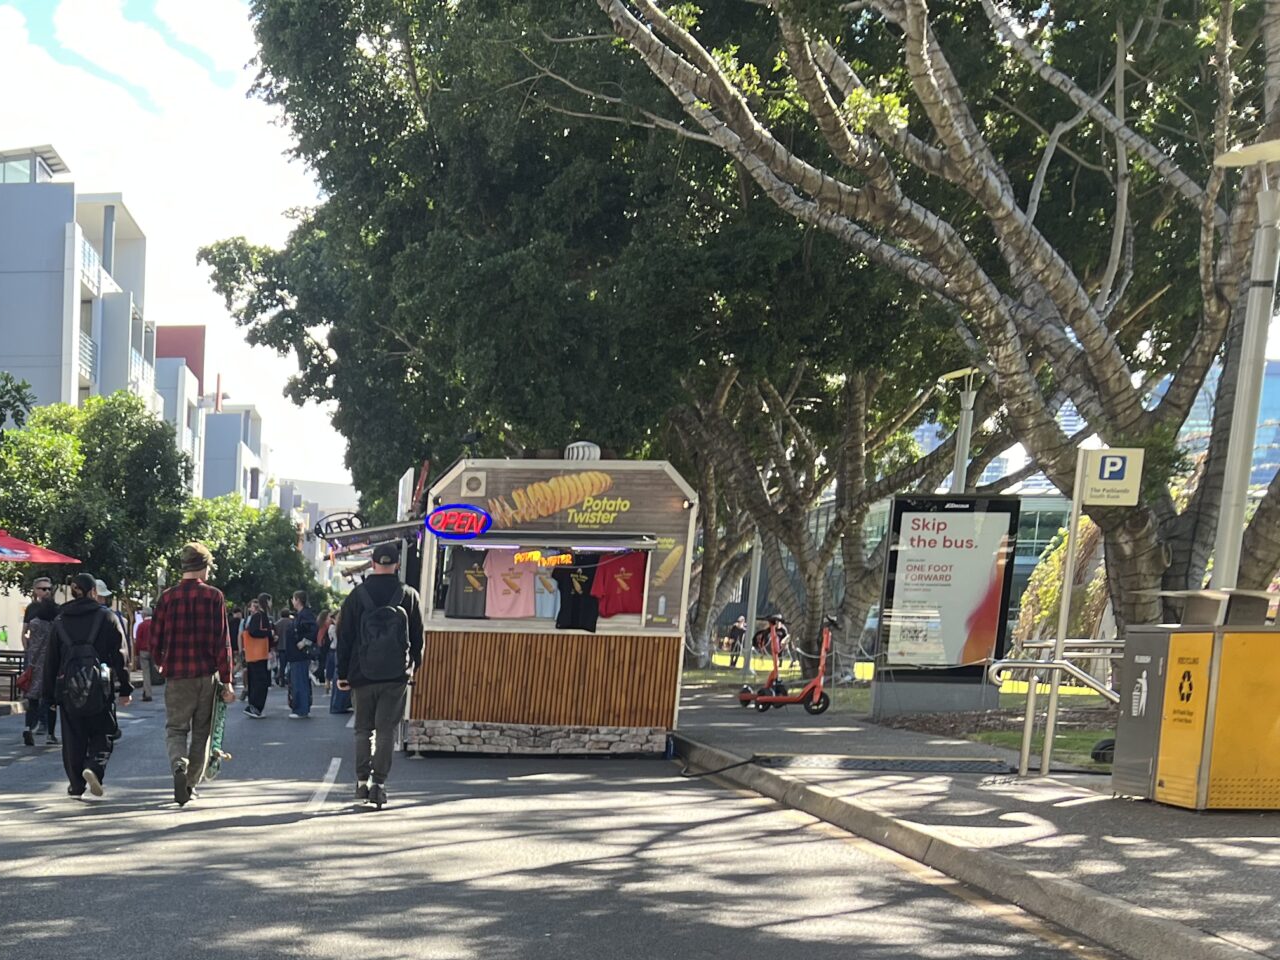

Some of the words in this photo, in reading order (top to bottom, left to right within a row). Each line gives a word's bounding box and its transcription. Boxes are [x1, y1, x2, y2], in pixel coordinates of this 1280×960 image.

[1103, 457, 1123, 478] P
[583, 497, 630, 512] Potato
[429, 511, 487, 534] OPEN
[567, 509, 617, 524] Twister
[911, 517, 948, 535] Skip
[910, 535, 938, 549] the
[942, 535, 978, 549] bus.
[905, 564, 926, 572] ONE
[927, 564, 954, 573] FOOT
[904, 573, 952, 582] FORWARD
